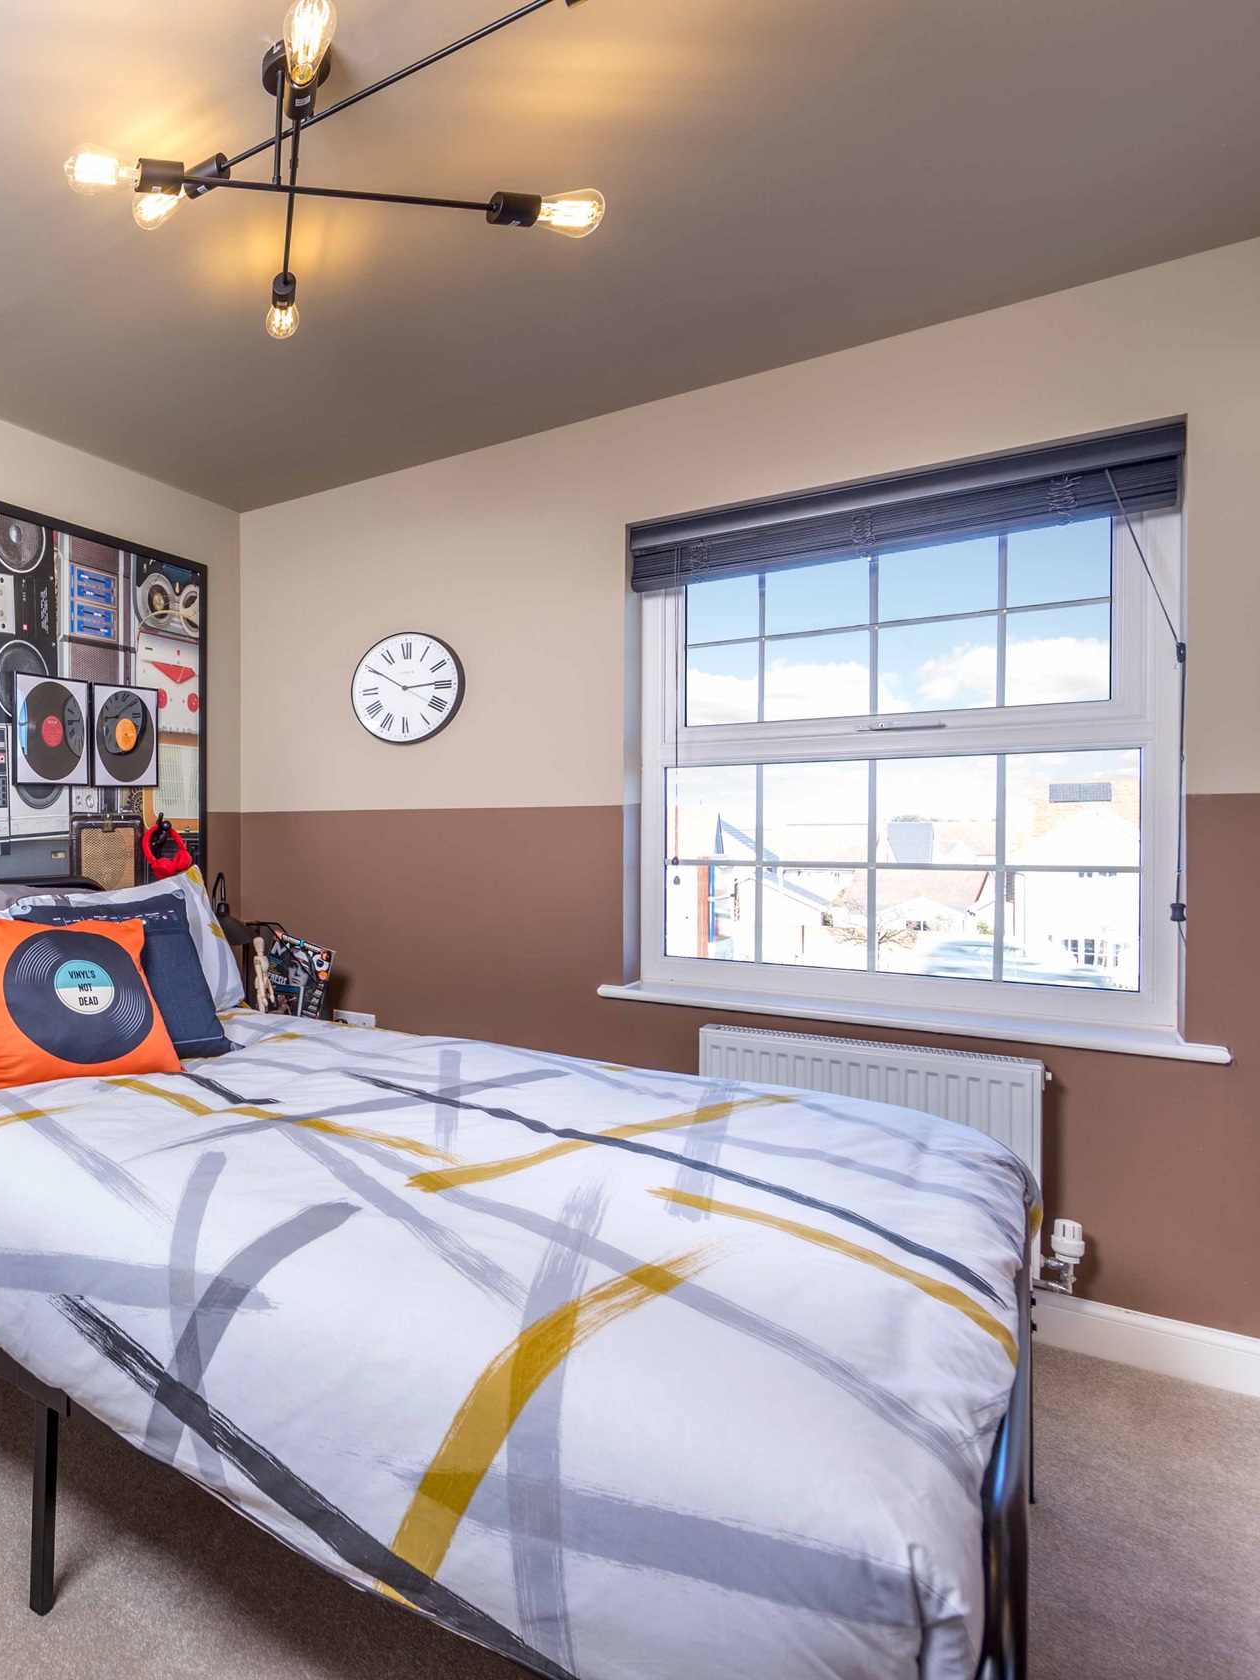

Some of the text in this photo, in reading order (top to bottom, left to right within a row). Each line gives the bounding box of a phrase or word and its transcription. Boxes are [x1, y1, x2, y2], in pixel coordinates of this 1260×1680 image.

[68, 970, 96, 979] VINYL'S
[78, 983, 92, 992] NOT
[78, 996, 99, 1006] DEAD
